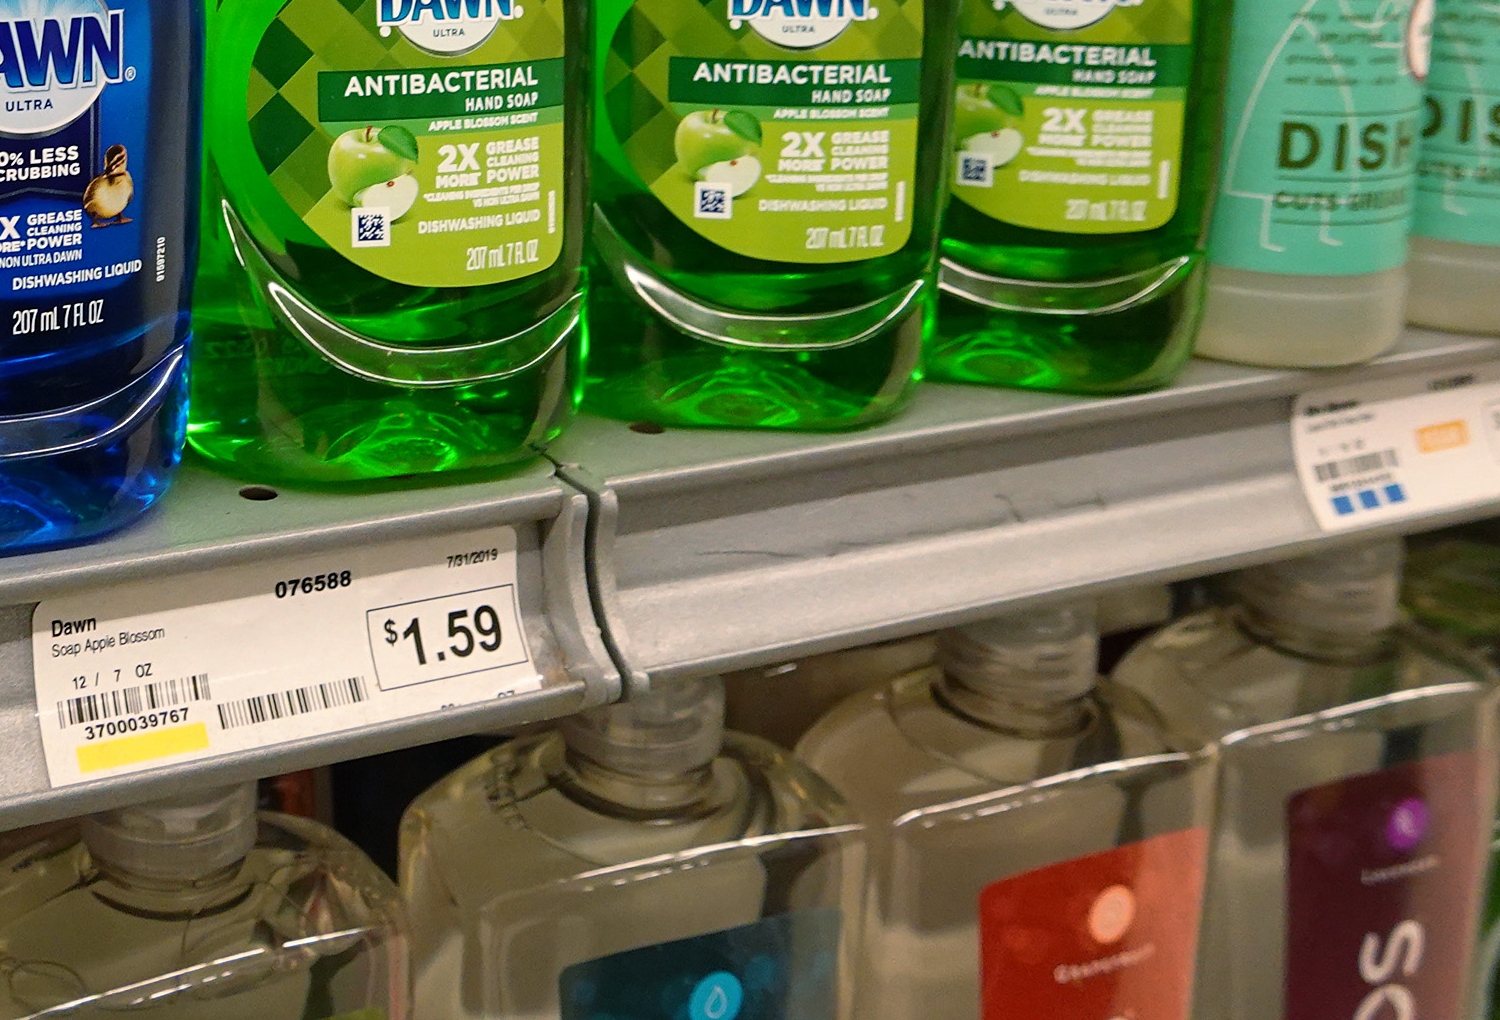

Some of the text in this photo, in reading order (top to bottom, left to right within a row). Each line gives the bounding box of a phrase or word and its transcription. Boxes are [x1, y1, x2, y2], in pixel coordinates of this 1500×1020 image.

[432, 28, 465, 38] ULTRA
[781, 25, 816, 34] ULTRA
[957, 39, 1157, 67] ANTIBACTERIAL
[344, 66, 539, 97] ANTIBACTERIAL
[693, 62, 892, 85] ANTIBACTERIAL
[5, 98, 54, 113] ULTRA
[465, 91, 539, 112] HAND SOAP
[811, 88, 891, 104] HAND SOAP
[428, 112, 539, 131] APPLE BLOSSOM SCENT
[1041, 107, 1088, 133] 2X
[485, 136, 540, 156] GREASE
[780, 130, 826, 158] 2X
[29, 145, 80, 165] LESS
[437, 142, 481, 173] 2X
[486, 151, 540, 168] CLEANING
[486, 164, 540, 184] POWER
[26, 209, 83, 226] GREASE
[418, 214, 504, 234] DISHWASHING
[505, 208, 541, 226] LIQUID
[26, 222, 83, 237] CLEANING
[26, 233, 83, 251] POWER
[21, 251, 53, 267] ULTRA
[53, 248, 83, 264] DAWN
[466, 246, 488, 271] 207
[12, 259, 143, 291] DISHWASHING LIQUID
[12, 299, 105, 335] 207 mL 7 FL OZ
[446, 548, 499, 568] 7/31/2019
[275, 570, 352, 598] 076588
[51, 617, 97, 637] Dawn
[384, 605, 502, 665] $1.59
[51, 627, 166, 658] Soap Apple Blossom
[72, 675, 87, 690] 12
[113, 669, 122, 683] 7
[135, 662, 153, 679] OZ
[84, 707, 190, 740] 3700039767
